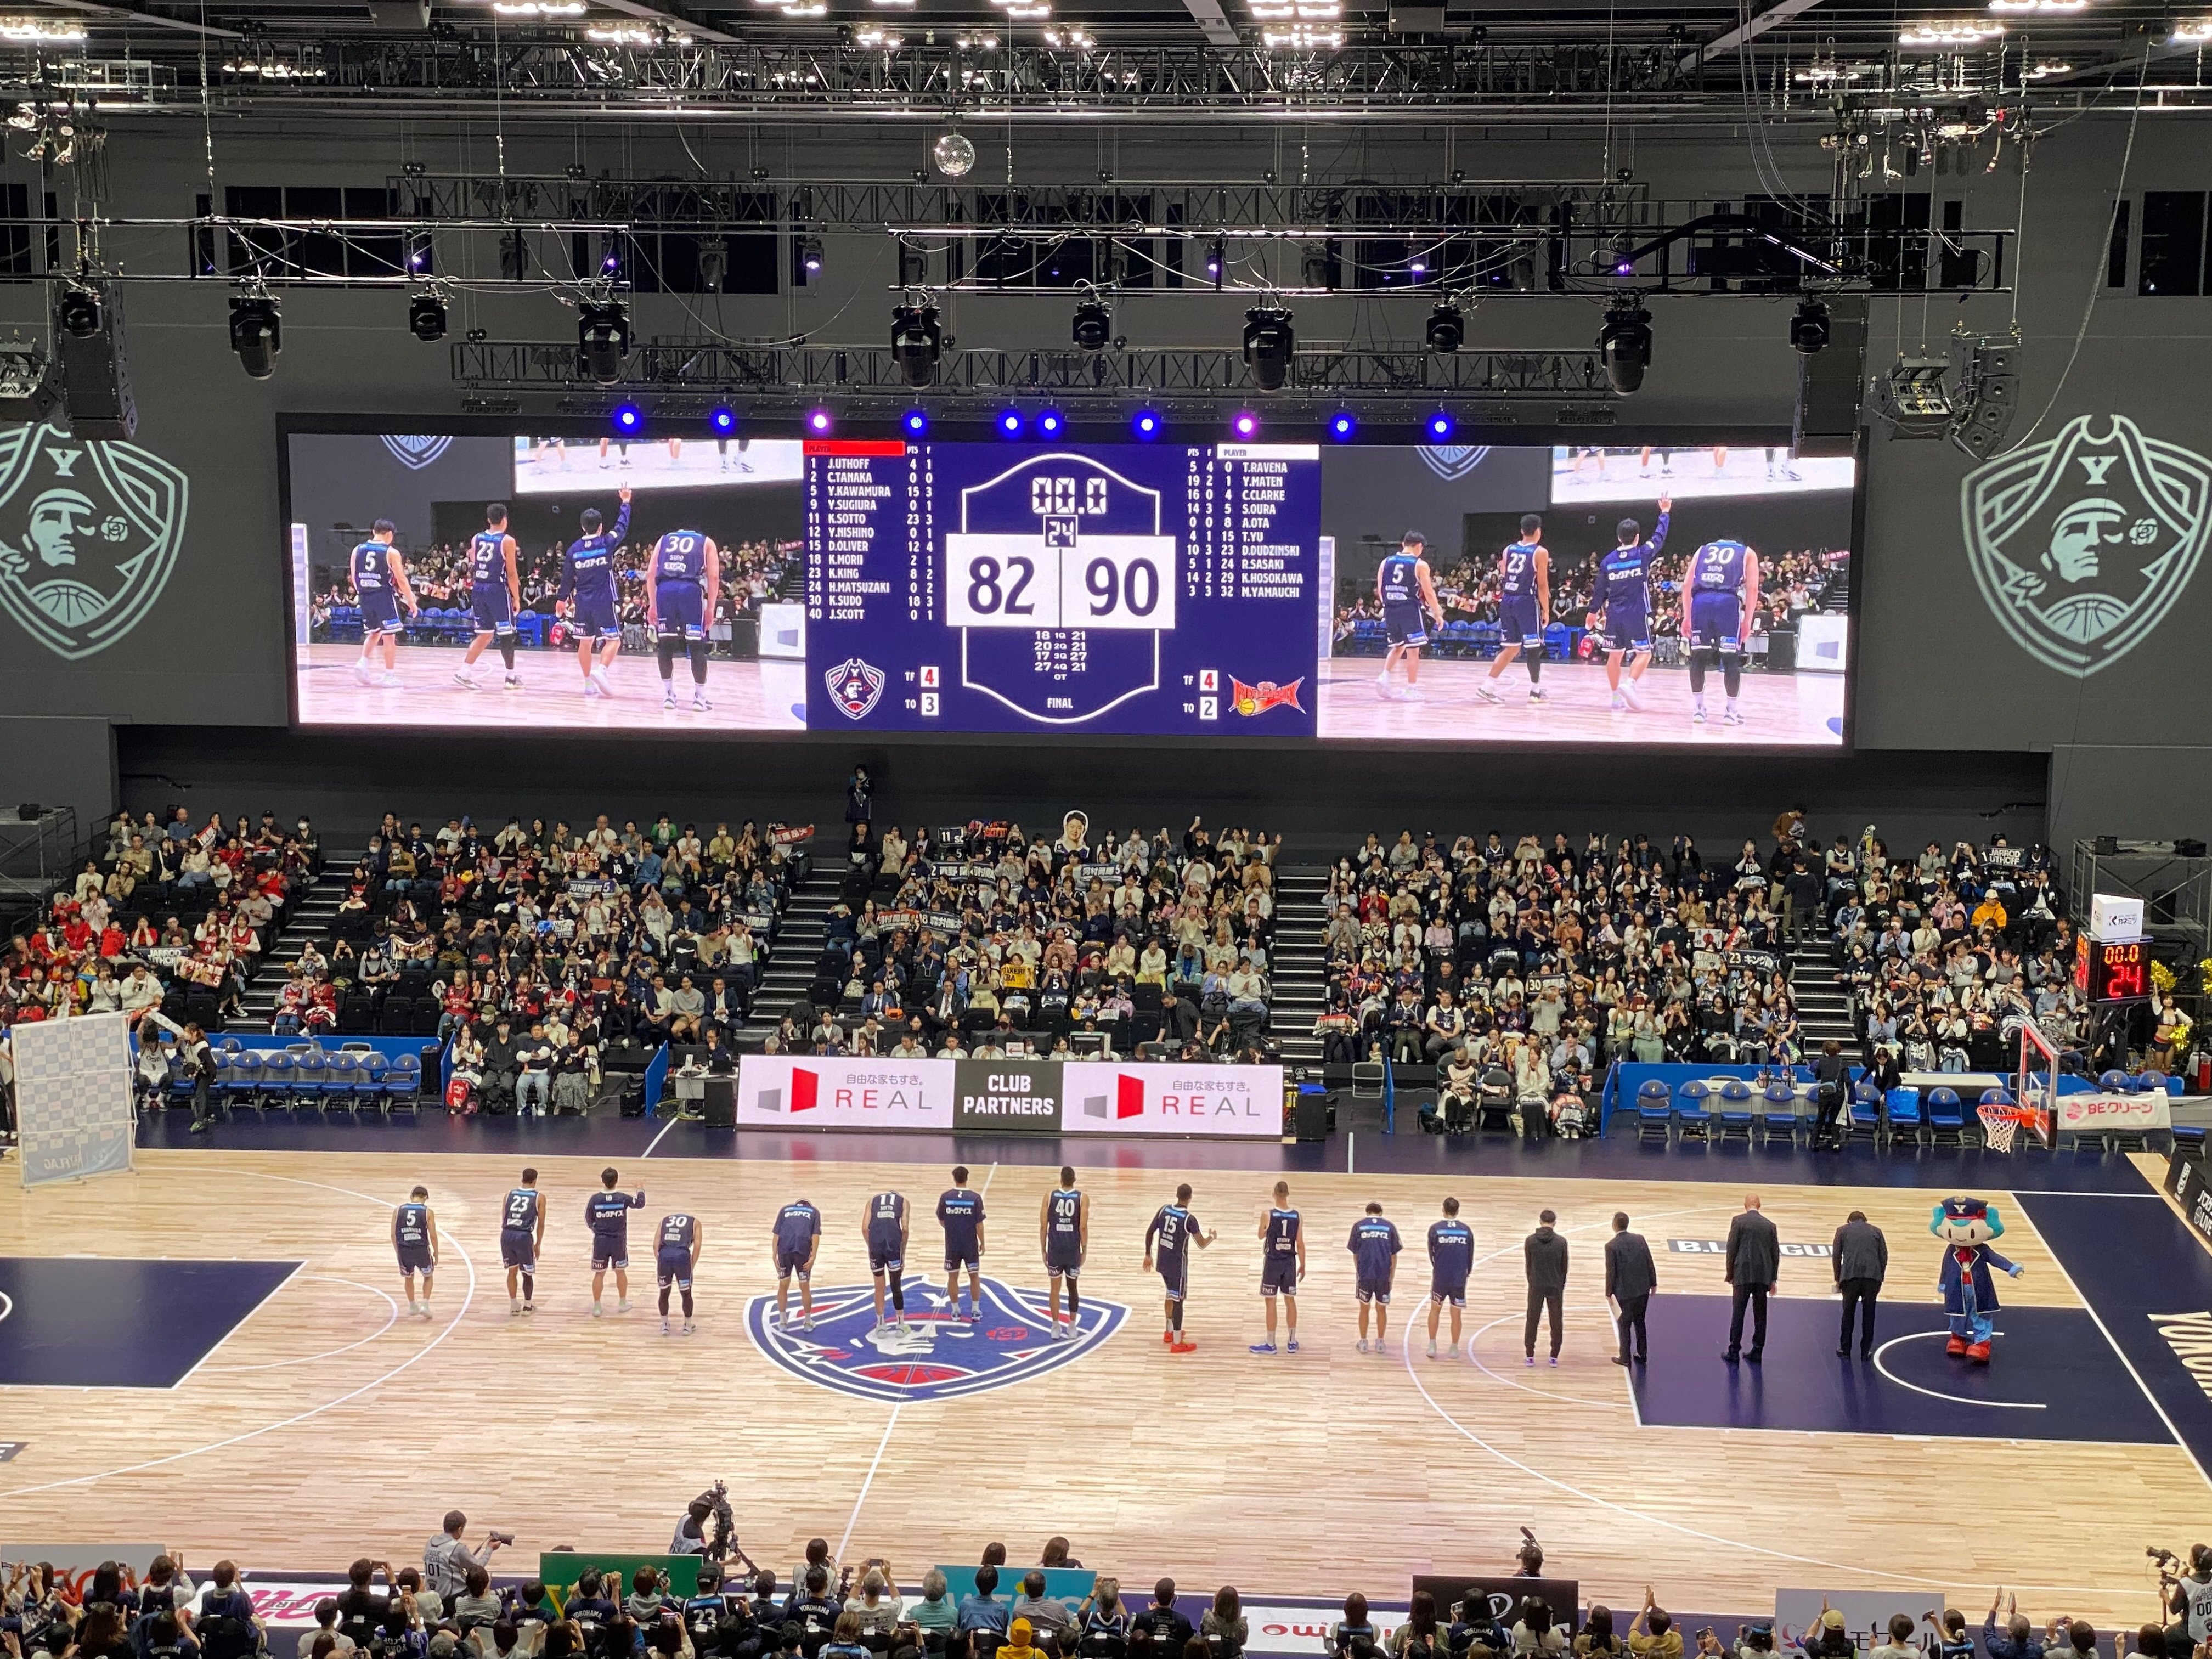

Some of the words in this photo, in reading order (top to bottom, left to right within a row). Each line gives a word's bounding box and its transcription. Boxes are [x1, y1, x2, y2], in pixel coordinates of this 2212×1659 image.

[907, 445, 919, 454] PTS
[926, 445, 931, 454] F
[1187, 448, 1199, 457] PTS
[1207, 448, 1212, 457] F
[45, 448, 82, 476] Y
[811, 457, 816, 469] 1
[827, 458, 870, 469] J.UTHOFF
[910, 458, 917, 470] 4
[926, 459, 932, 470] 1
[1189, 461, 1197, 472] 5
[1206, 461, 1214, 472] 4
[1224, 461, 1232, 473] 0
[1242, 462, 1288, 473] T.RAVENA
[2077, 456, 2118, 484] Y
[810, 471, 817, 483] 2
[827, 471, 873, 483] C.TANAKA
[909, 472, 917, 484] 0
[925, 472, 933, 484] 0
[1187, 475, 1200, 487] 19
[1206, 475, 1213, 487] 2
[1226, 475, 1231, 487] 1
[1242, 476, 1283, 487] Y.MATEN
[810, 484, 817, 496] 5
[827, 486, 891, 497] Y.KAWAMURA
[907, 486, 920, 498] 15
[926, 486, 933, 498] 3
[1032, 477, 1107, 514] 00.0
[1187, 488, 1200, 500] 16
[1205, 488, 1214, 500] 0
[1224, 489, 1232, 500] 4
[1242, 489, 1285, 501] C.CLARKE
[810, 499, 817, 510] 9
[827, 499, 877, 511] Y.SUGIURA
[909, 500, 917, 511] 0
[927, 500, 932, 511] 1
[1187, 503, 1200, 514] 14
[1205, 503, 1212, 514] 3
[1224, 503, 1232, 514] 5
[1242, 503, 1276, 515] S.OURA
[808, 512, 820, 524] 11
[828, 513, 866, 524] K.SOTTO
[906, 513, 919, 525] 23
[926, 514, 933, 526] 3
[1189, 516, 1197, 528] 0
[1205, 516, 1213, 528] 0
[1224, 517, 1232, 528] 8
[1242, 517, 1270, 529] A.OTA
[809, 526, 821, 538] 12
[828, 527, 874, 538] Y.NISHINO
[910, 527, 917, 539] 0
[927, 527, 932, 539] 1
[1048, 521, 1074, 546] 24
[1189, 530, 1197, 541] 4
[1206, 530, 1211, 542] 1
[1222, 531, 1234, 542] 15
[1242, 531, 1263, 543] T.YU
[665, 536, 694, 552] 30
[809, 540, 821, 551] 15
[828, 540, 868, 552] D.OLIVER
[908, 541, 919, 552] 12
[926, 541, 933, 552] 4
[1187, 544, 1200, 556] 10
[1205, 544, 1212, 556] 3
[1221, 544, 1234, 556] 23
[1242, 545, 1300, 556] D.DUDZINSKI
[476, 541, 494, 561] 23
[1703, 546, 1735, 564] 30
[365, 551, 376, 571] 5
[575, 557, 608, 569] ロックアイス
[809, 554, 821, 565] 18
[828, 554, 864, 565] K.MORII
[910, 555, 917, 566] 2
[927, 555, 932, 566] 1
[1189, 557, 1196, 569] 5
[1206, 558, 1211, 569] 1
[1221, 558, 1234, 569] 24
[1242, 558, 1284, 570] R.SASAKI
[1507, 553, 1526, 573] 23
[808, 567, 821, 579] 23
[828, 568, 859, 579] K.KING
[910, 568, 917, 580] 8
[926, 568, 933, 580] 2
[1187, 572, 1199, 583] 14
[1205, 572, 1212, 583] 2
[1221, 572, 1234, 583] 29
[1242, 572, 1304, 584] K.HOSOKAWA
[808, 580, 822, 592] 24
[829, 582, 890, 593] H.MATSUZAKI
[910, 582, 917, 594] 0
[926, 582, 933, 594] 2
[968, 556, 1035, 615] 82
[1085, 557, 1159, 617] 90
[1189, 585, 1196, 597] 3
[1205, 585, 1212, 597] 3
[1221, 585, 1234, 597] 32
[1241, 586, 1300, 598] M.YAMAUCHI
[809, 594, 822, 606] 30
[829, 595, 862, 606] K.SUDO
[908, 596, 921, 607] 18
[926, 596, 933, 607] 3
[809, 608, 822, 619] 40
[829, 608, 865, 620] J.SCOTT
[910, 609, 918, 620] 0
[927, 610, 932, 621] 1
[1035, 631, 1050, 640] 18
[1071, 631, 1085, 640] 21
[1034, 641, 1052, 651] 20
[1071, 642, 1085, 651] 21
[1036, 652, 1049, 661] 17
[1070, 652, 1087, 661] 27
[1035, 662, 1052, 671] 27
[1071, 662, 1085, 672] 21
[905, 672, 915, 681] TF
[924, 669, 934, 685] 4
[1183, 675, 1193, 685] TF
[1204, 673, 1214, 689] 4
[905, 699, 916, 709] TO
[926, 696, 934, 712] 3
[1047, 698, 1073, 708] FINAL
[1183, 703, 1194, 713] TO
[1204, 700, 1213, 716] 2
[1982, 851, 1988, 862] 1
[1989, 849, 2021, 857] JARROD
[1989, 855, 2019, 865] UTHOFF
[2104, 944, 2138, 964] 00.0
[2109, 966, 2140, 996] 24
[847, 1074, 923, 1085] 自由な家もすき。
[988, 1075, 1031, 1092] CLUB
[1173, 1081, 1250, 1092] 自由な家もすき。
[836, 1089, 932, 1109] REAL
[963, 1096, 1054, 1115] PARTNERS
[1163, 1096, 1260, 1116] REAL
[510, 1195, 529, 1212] 23
[880, 1194, 895, 1205] 11
[1056, 1199, 1075, 1217] 40
[406, 1210, 416, 1226] 5
[666, 1216, 687, 1227] 30
[1164, 1215, 1177, 1234] 15
[1282, 1219, 1287, 1237] 1
[798, 1605, 830, 1616] YOKOHAMA
